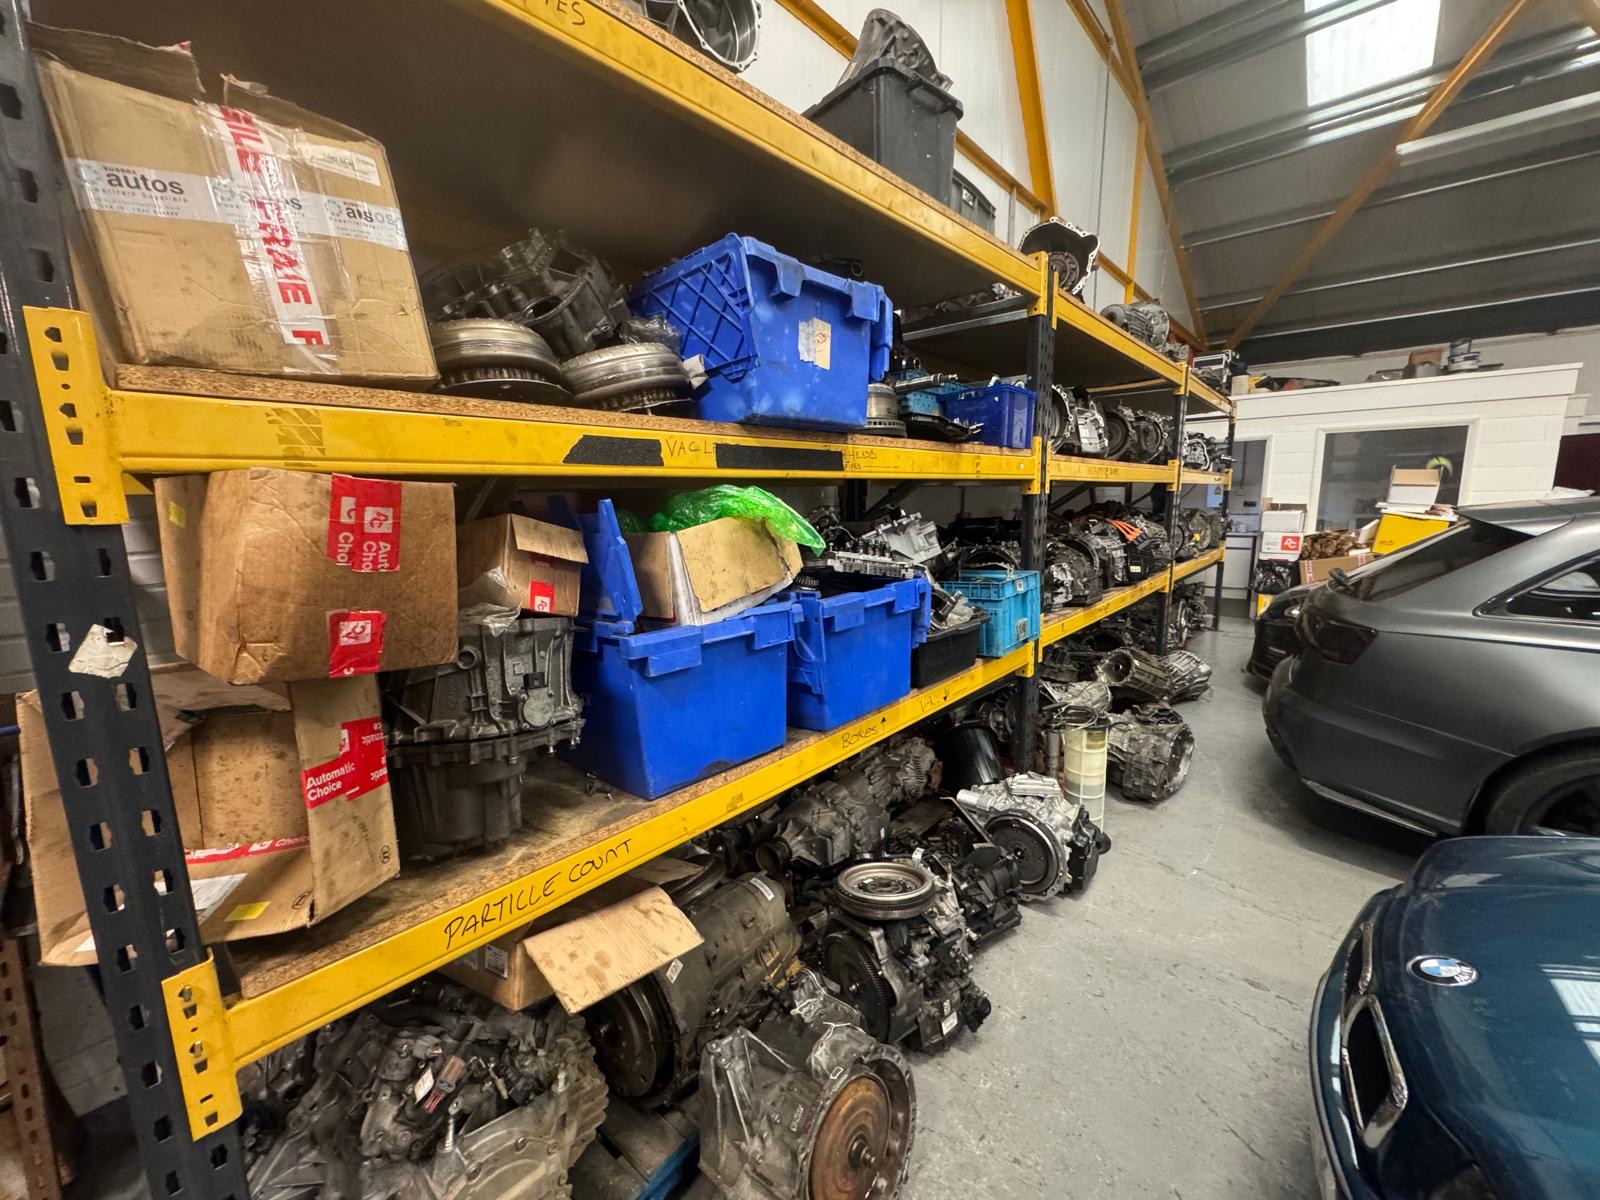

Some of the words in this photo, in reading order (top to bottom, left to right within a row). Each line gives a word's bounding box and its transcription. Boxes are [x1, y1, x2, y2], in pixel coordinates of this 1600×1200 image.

[106, 172, 185, 195] autos
[1283, 537, 1297, 549] AC
[305, 761, 356, 791] Automatic
[307, 780, 343, 801] Choice
[444, 871, 561, 950] PARTICLE
